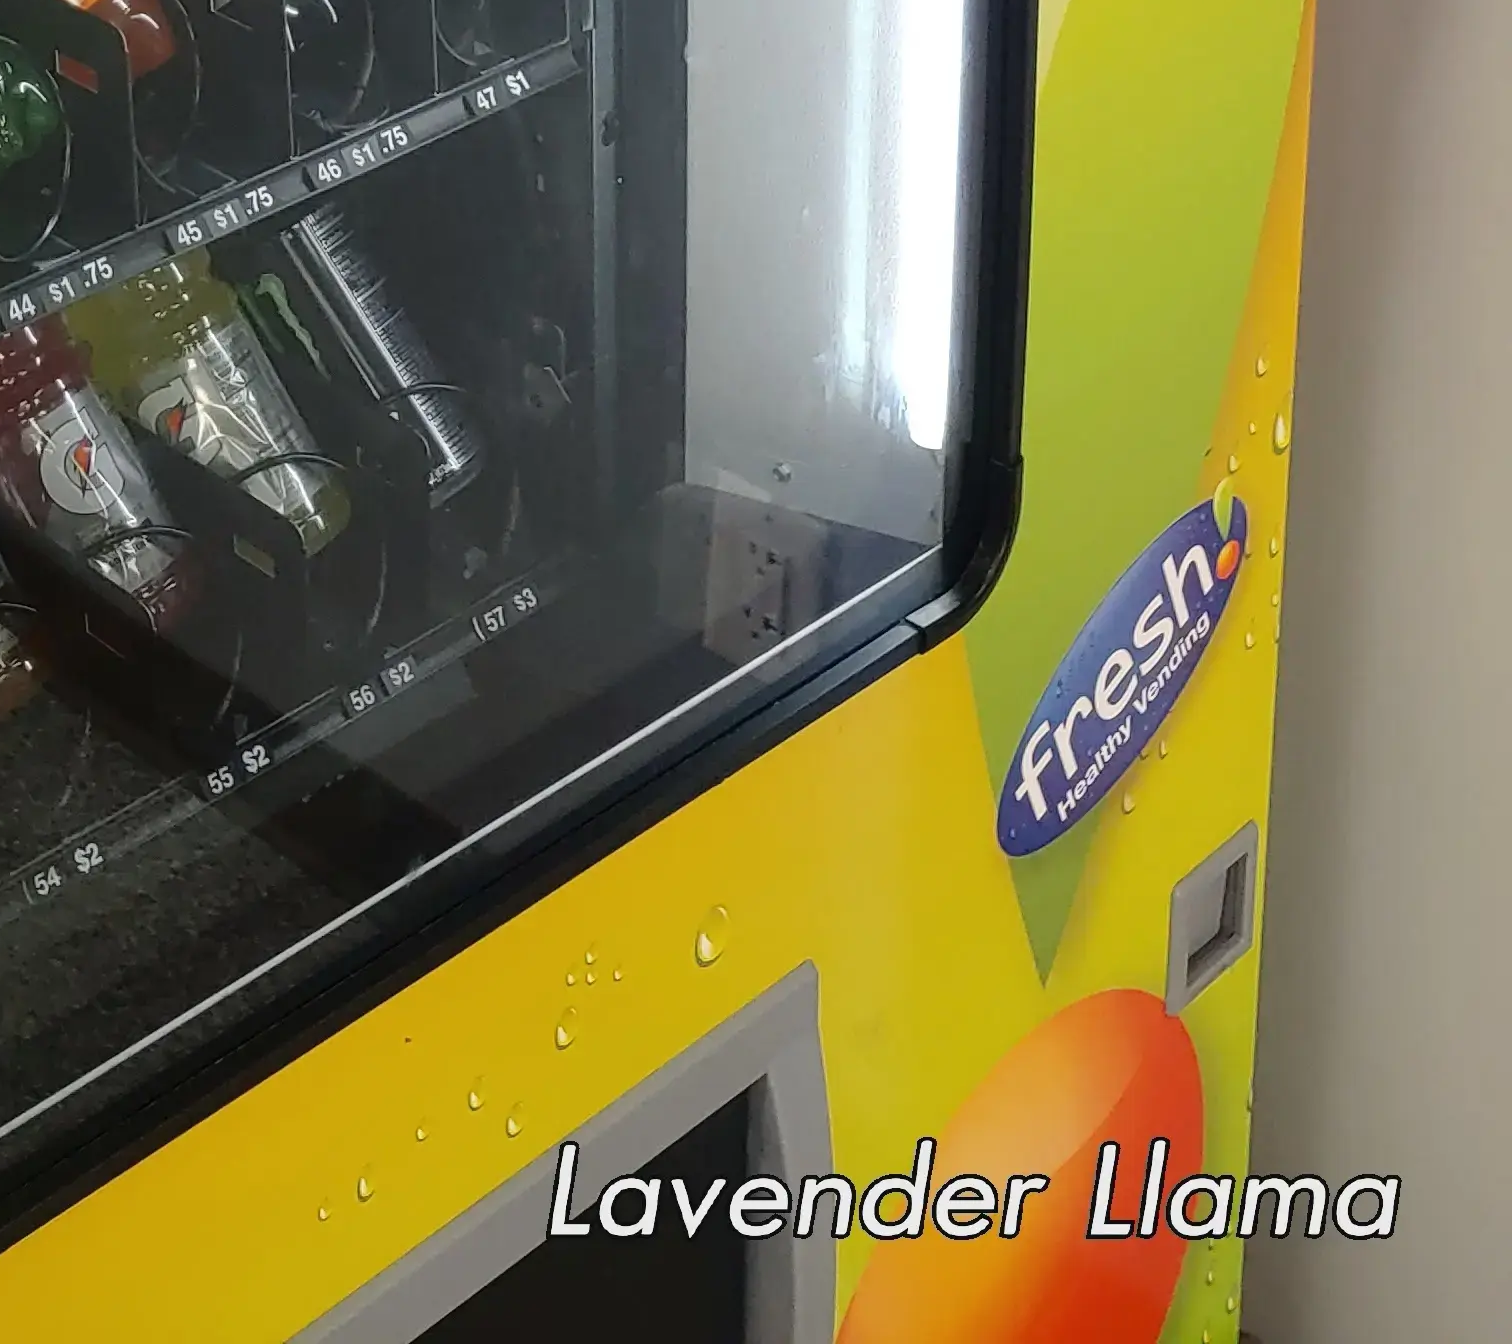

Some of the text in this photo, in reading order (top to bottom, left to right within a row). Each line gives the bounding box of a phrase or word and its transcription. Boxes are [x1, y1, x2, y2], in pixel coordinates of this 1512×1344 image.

[475, 70, 531, 111] 47 $1
[316, 125, 409, 182] 46 $1 .75
[175, 185, 275, 246] 45 $1 .75
[7, 257, 114, 323] 44 $1 .75
[483, 586, 539, 633] 57 $3
[350, 660, 415, 712] 56 $2
[1055, 610, 1212, 823] Healthy Vending
[207, 744, 271, 796] 55 $2
[33, 843, 105, 898] 54 $2
